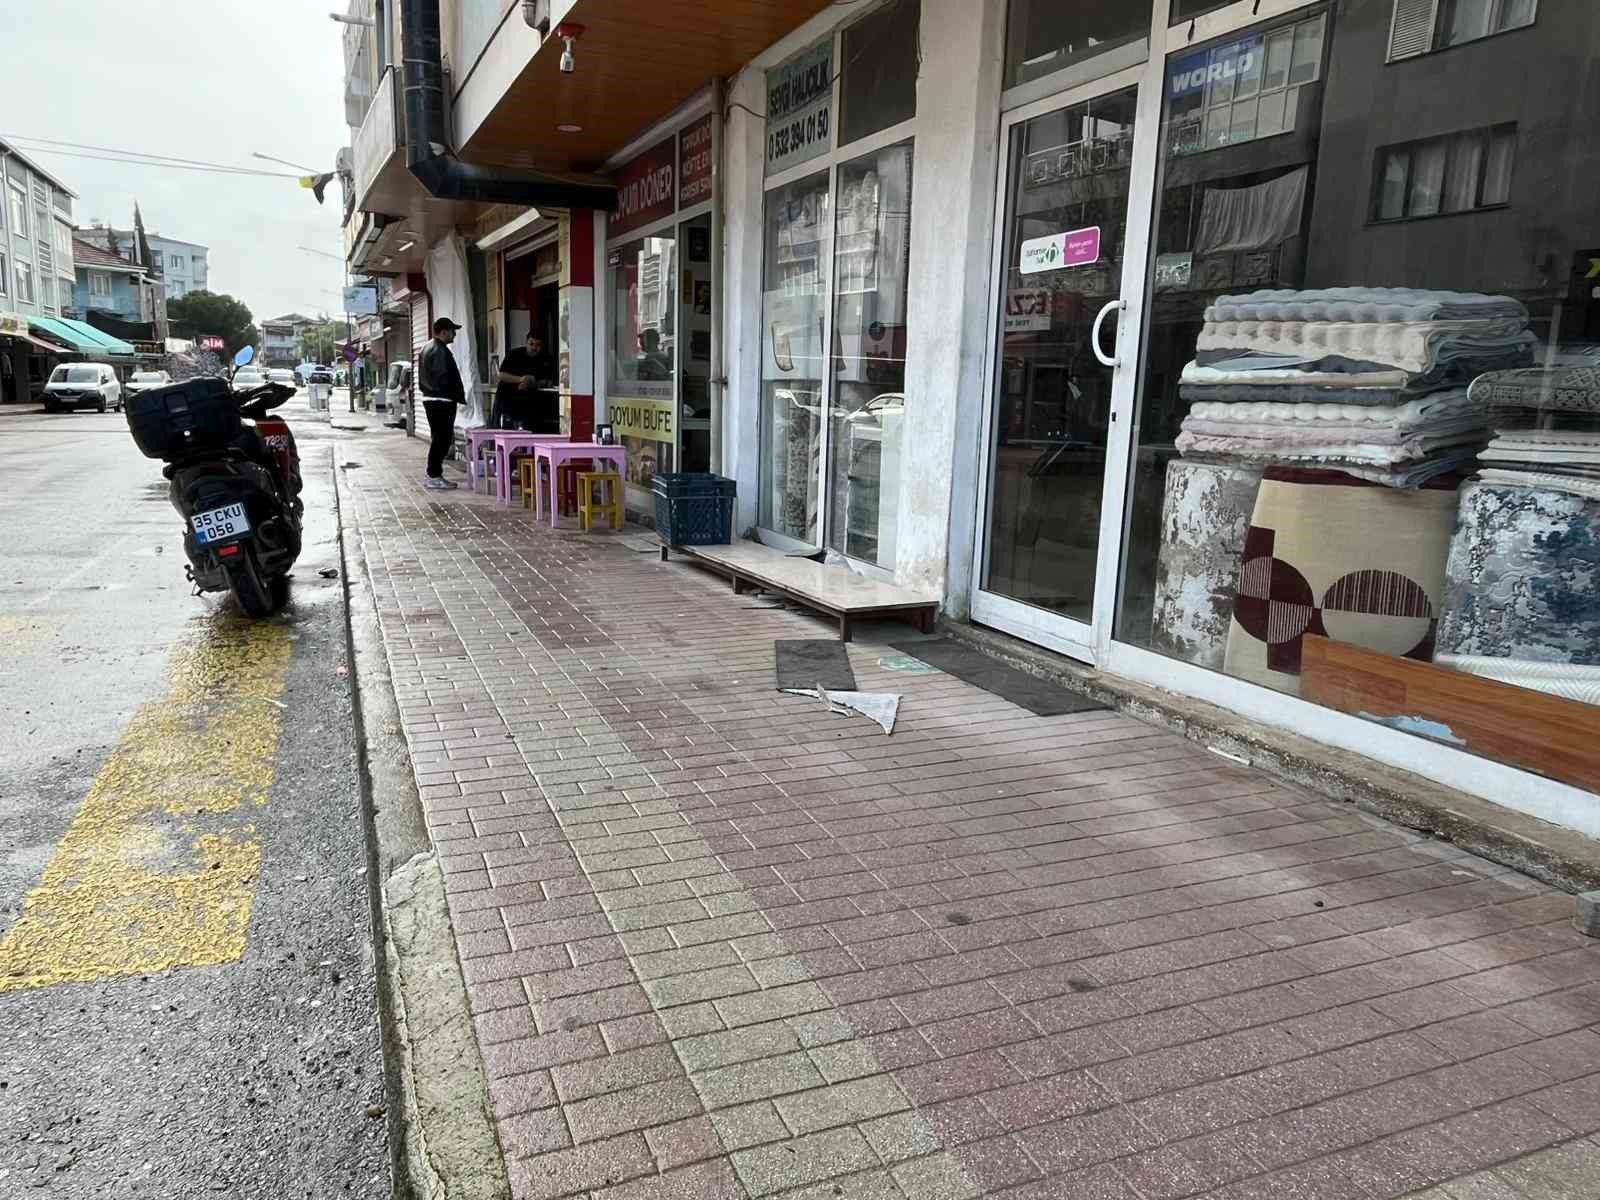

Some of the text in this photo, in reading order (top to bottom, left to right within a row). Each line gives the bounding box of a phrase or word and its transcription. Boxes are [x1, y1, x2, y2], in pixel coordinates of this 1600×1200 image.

[1173, 52, 1254, 93] WORLD
[768, 133, 774, 161] 0
[806, 115, 816, 144] 01
[817, 107, 829, 140] 50
[640, 164, 673, 209] DÖNER
[609, 405, 672, 432] DOYUM BÜFE
[193, 505, 241, 528] 35 CKU
[207, 522, 234, 539] 058
